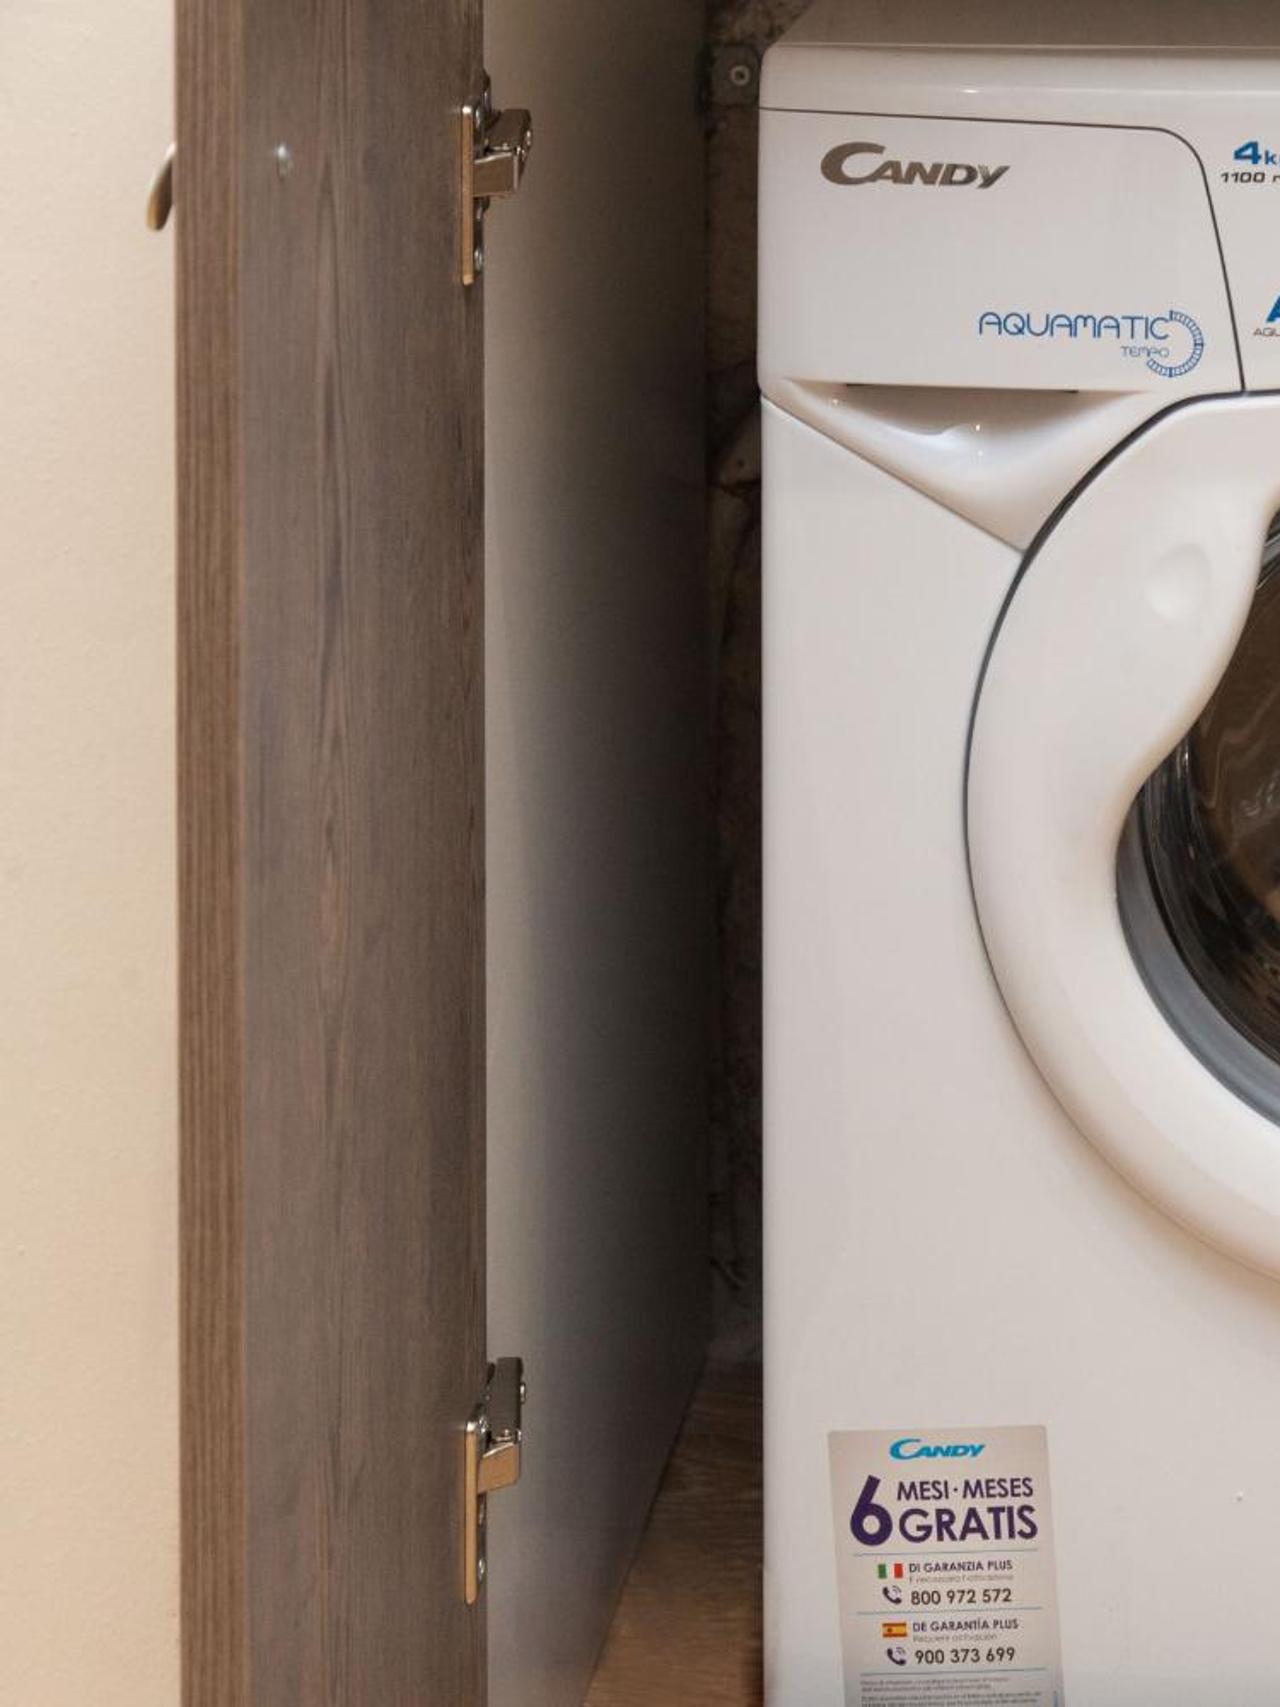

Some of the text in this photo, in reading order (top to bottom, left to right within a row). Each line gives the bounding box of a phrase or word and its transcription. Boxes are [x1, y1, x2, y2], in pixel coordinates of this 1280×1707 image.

[820, 141, 1010, 188] CANDY
[1221, 172, 1265, 183] 1100
[979, 311, 1169, 340] AQUAMATIC
[1120, 346, 1170, 358] TEMPO
[897, 1477, 1033, 1501] MESI MESES
[850, 1474, 893, 1547] 6
[899, 1504, 1038, 1543] GRATIS
[909, 1560, 1013, 1573] DI GARANZIA PLUS
[911, 1588, 1012, 1605] 800 972 572
[912, 1622, 928, 1632] DE
[993, 1619, 1019, 1630] PLUS
[915, 1647, 1015, 1664] 900 373 699
